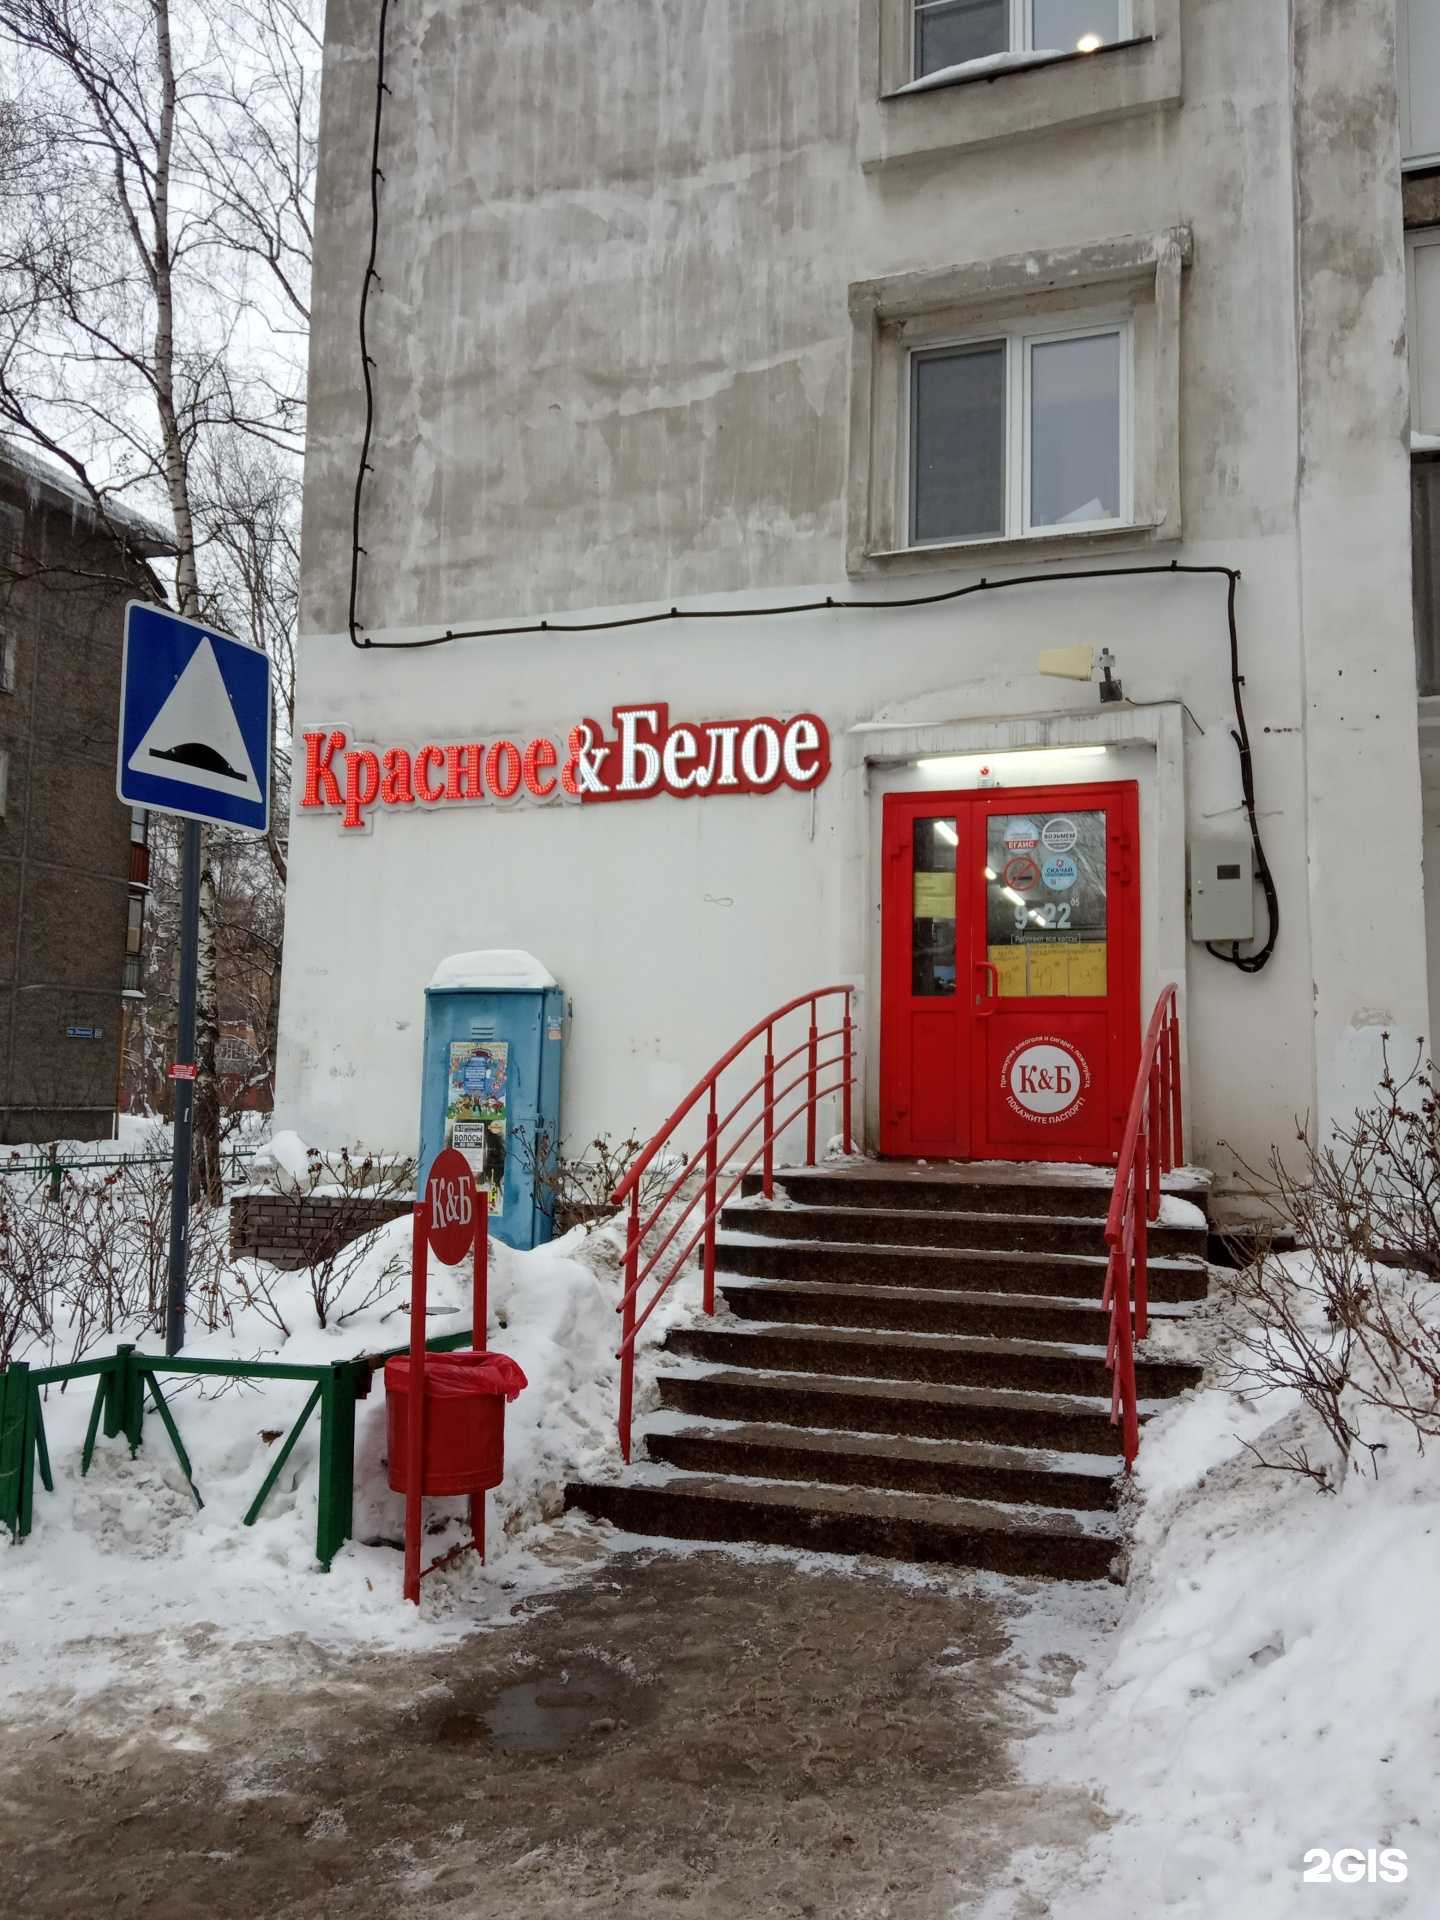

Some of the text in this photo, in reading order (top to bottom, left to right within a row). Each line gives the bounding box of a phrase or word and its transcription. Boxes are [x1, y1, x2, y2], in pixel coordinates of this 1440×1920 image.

[1018, 1064, 1072, 1094] К&Б
[1006, 1095, 1048, 1124] ПОКАЖИТЕ
[454, 1134, 483, 1142] ВОЛОСЫ
[430, 1175, 473, 1229] К&Б
